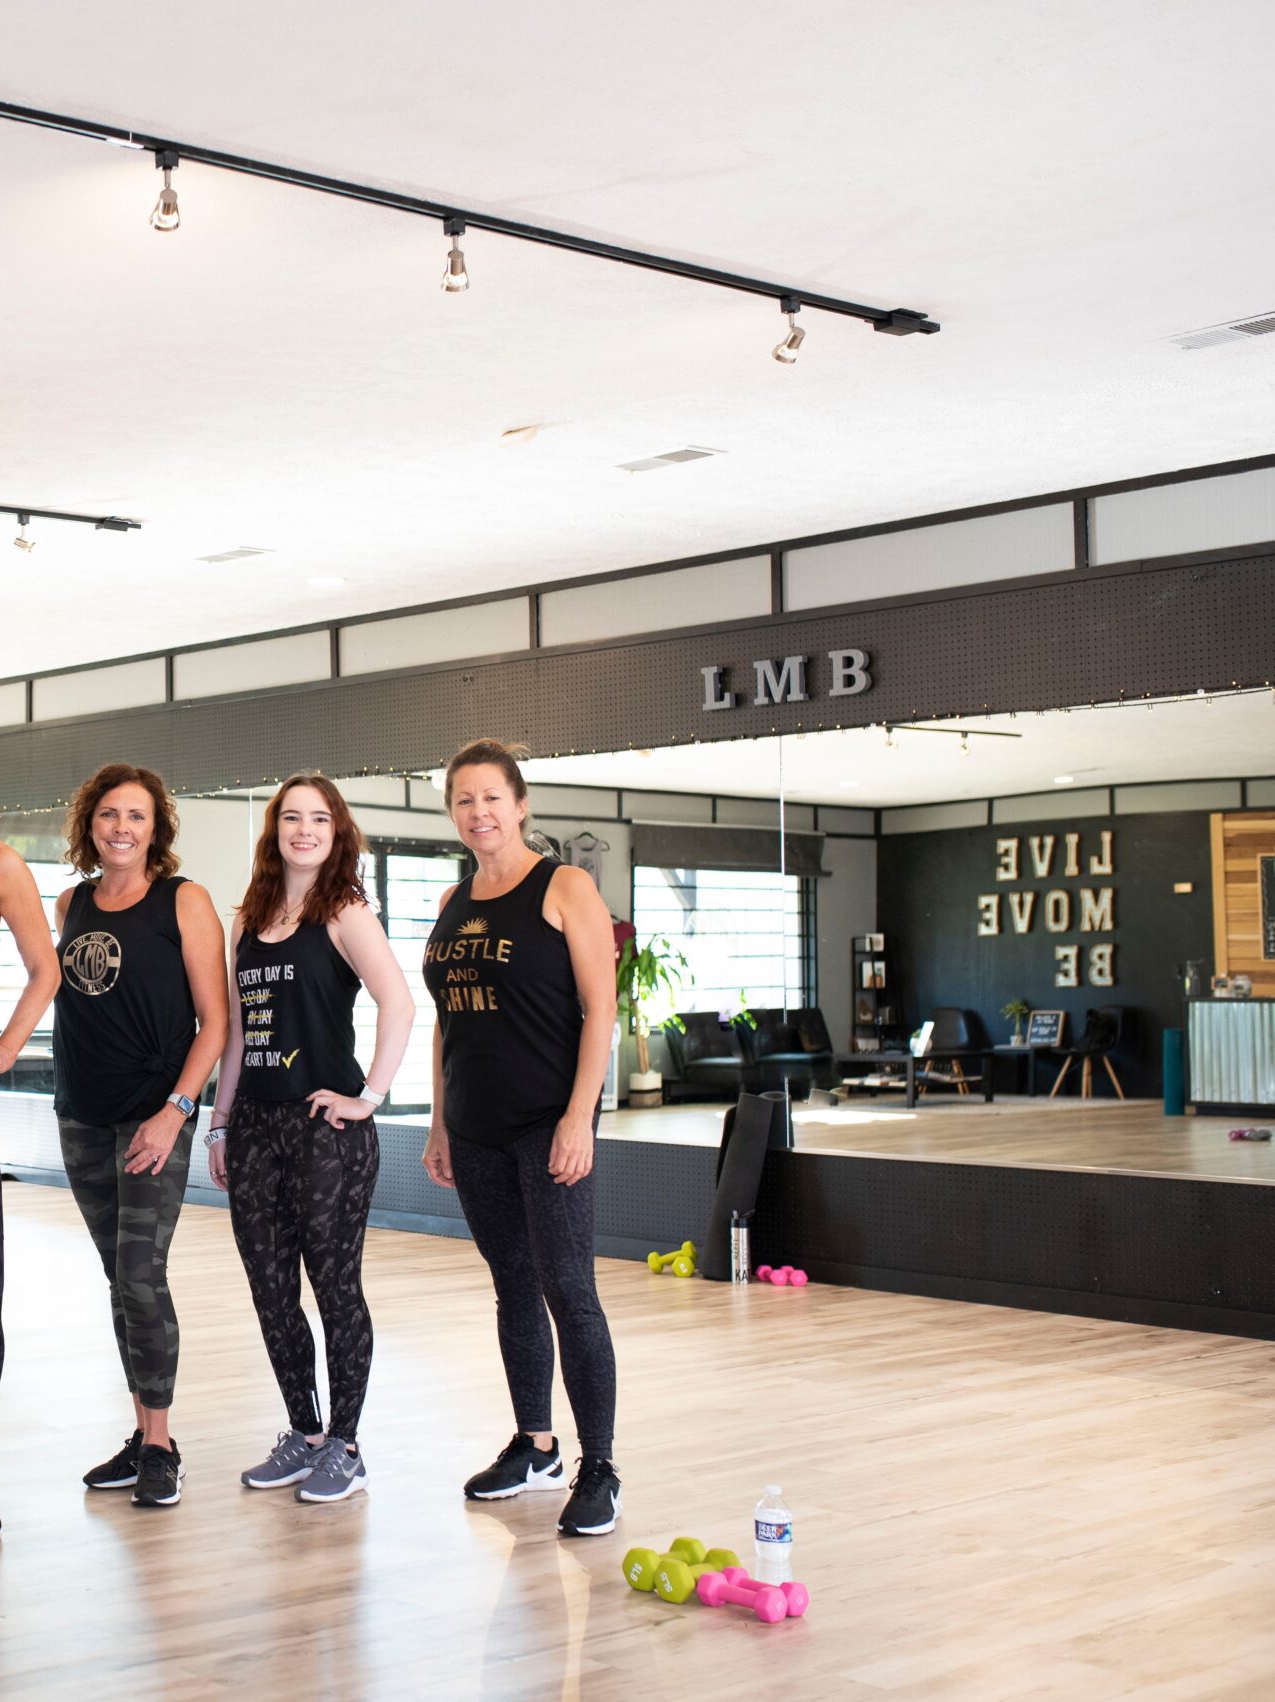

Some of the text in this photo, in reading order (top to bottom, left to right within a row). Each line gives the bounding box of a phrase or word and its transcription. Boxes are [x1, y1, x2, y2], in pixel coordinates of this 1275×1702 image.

[76, 944, 106, 980] LMB
[424, 938, 513, 966] HUSTLE
[238, 964, 294, 987] EVERY DAY IS
[446, 968, 479, 982] AND
[440, 986, 499, 1012] SHINE
[266, 1051, 281, 1067] DAY
